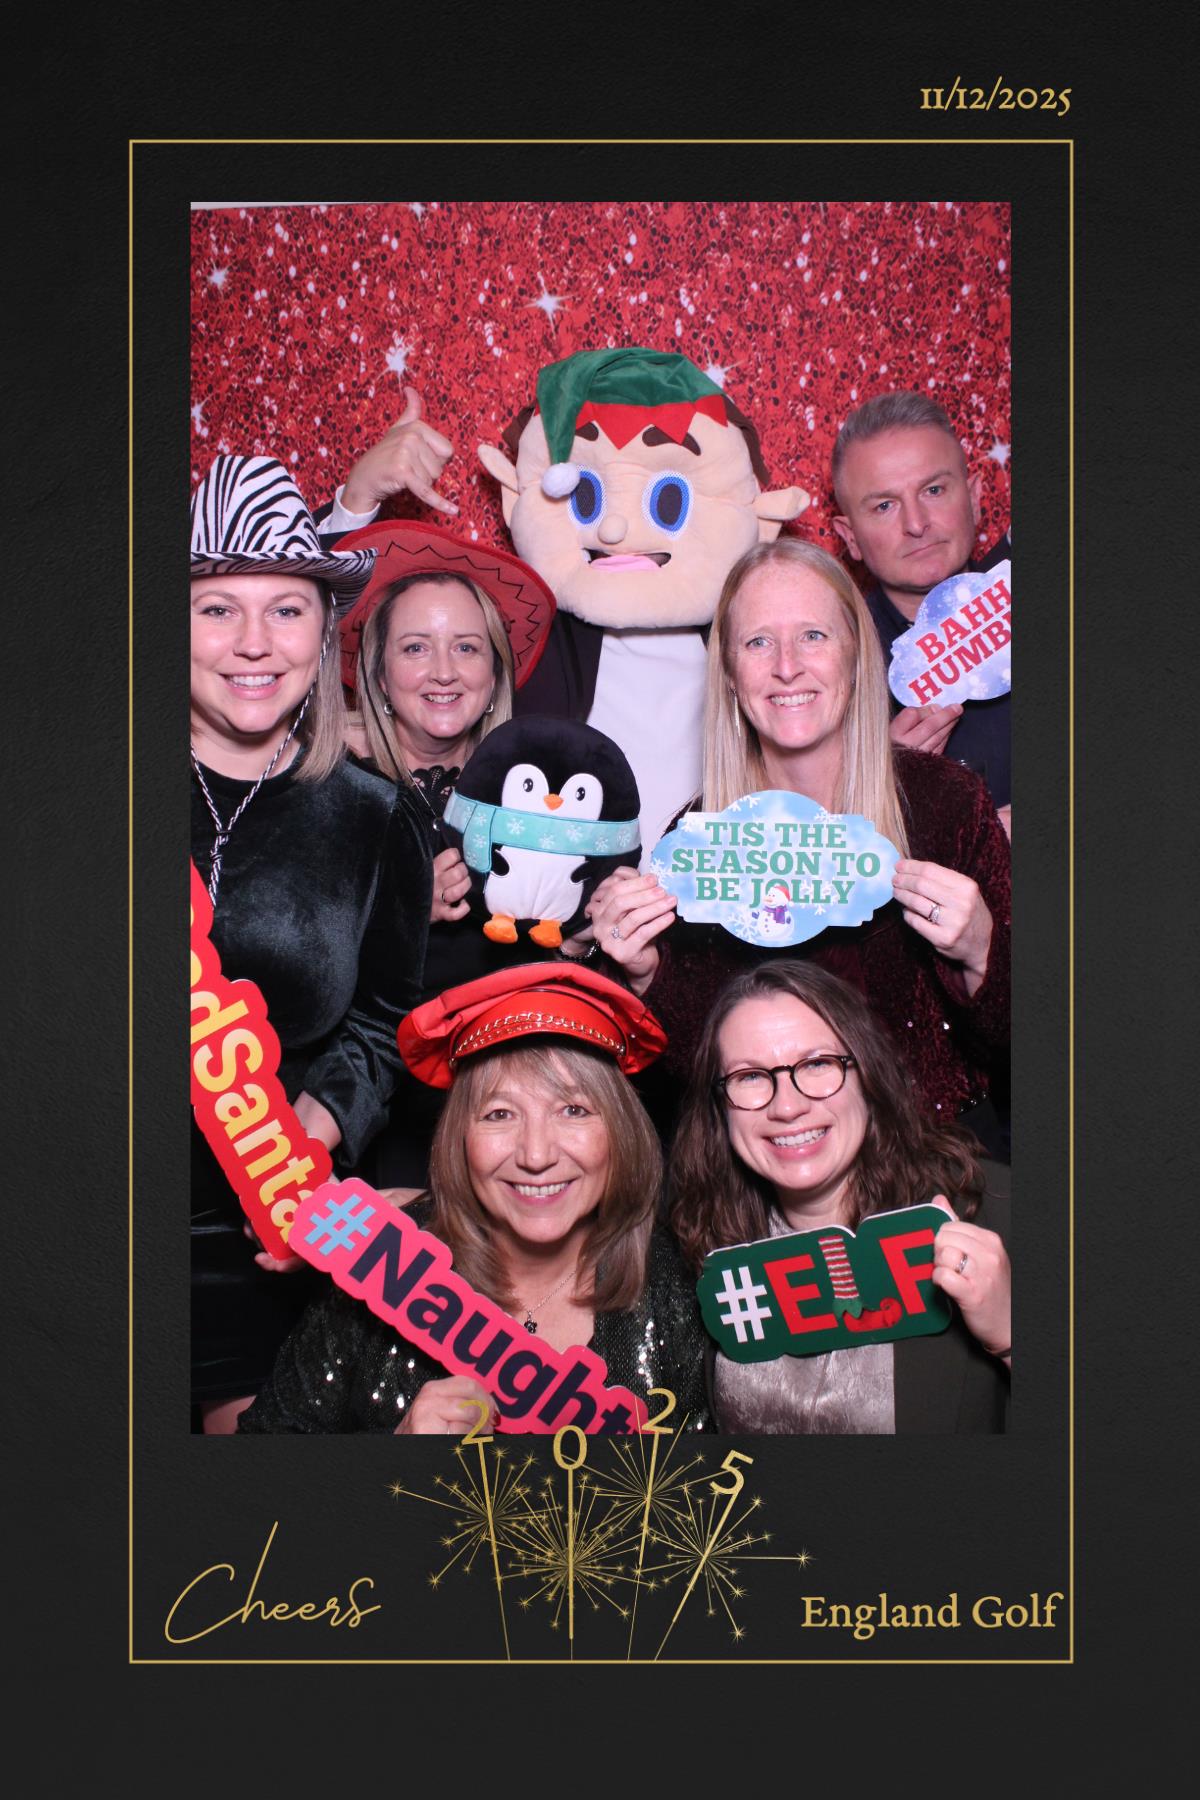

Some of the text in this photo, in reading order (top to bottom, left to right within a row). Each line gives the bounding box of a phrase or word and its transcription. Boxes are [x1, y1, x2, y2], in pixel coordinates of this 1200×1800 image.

[915, 579, 1011, 664] BAHH
[908, 612, 1011, 705] HUMB
[671, 848, 881, 877] SEASON TO
[705, 821, 847, 848] TIS THE
[696, 877, 740, 901] BE
[304, 1193, 637, 1434] #Naught
